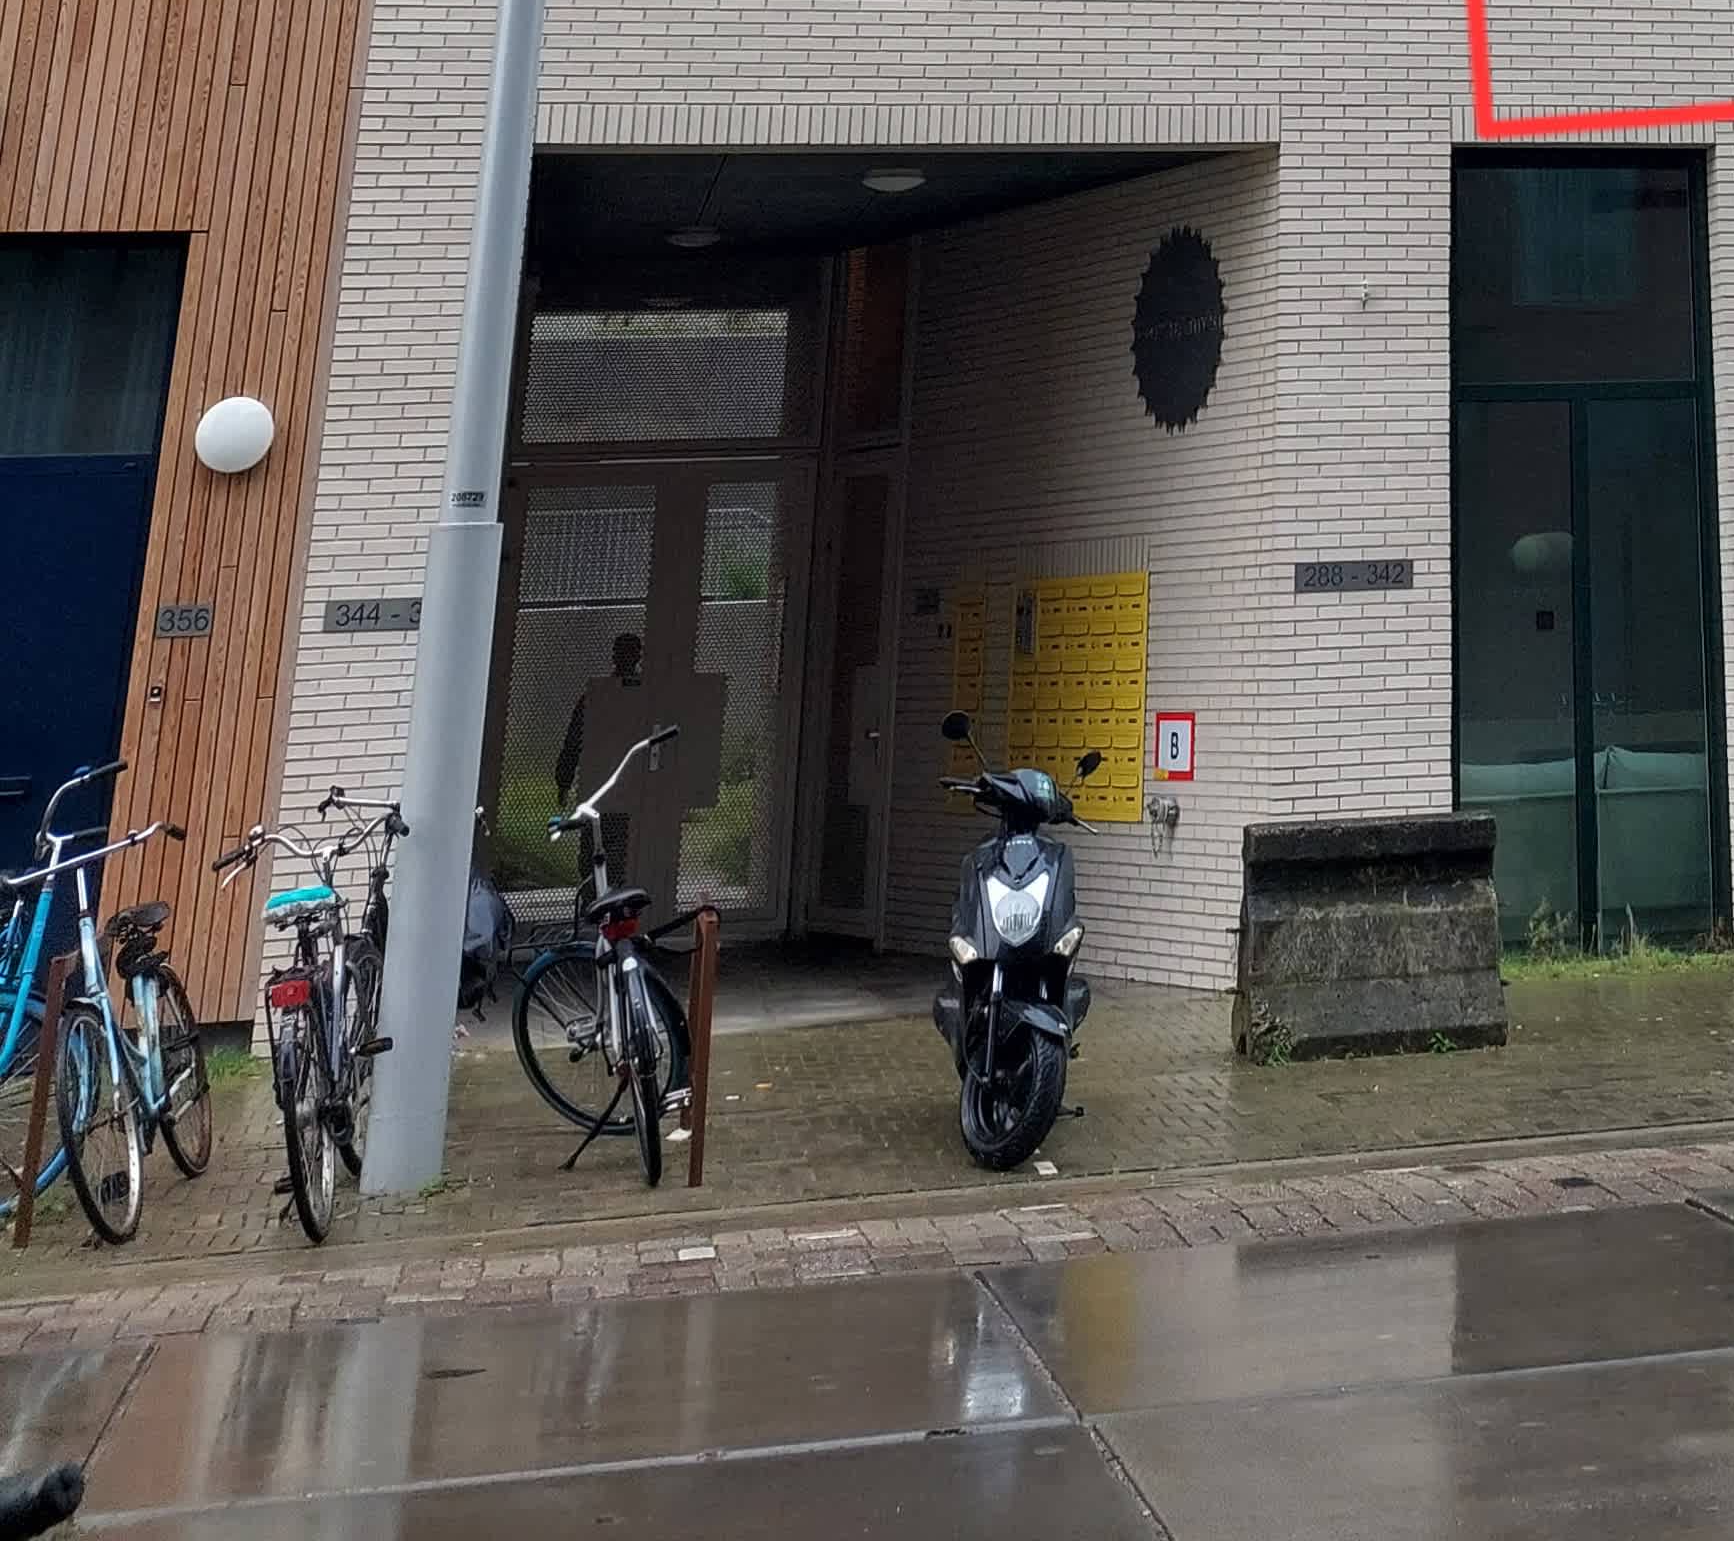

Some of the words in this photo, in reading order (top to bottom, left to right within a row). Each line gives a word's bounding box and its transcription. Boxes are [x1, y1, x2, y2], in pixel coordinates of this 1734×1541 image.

[1303, 565, 1343, 587] 288
[1367, 563, 1405, 585] 342
[160, 608, 209, 632] 356
[335, 603, 380, 626] 344
[409, 600, 422, 623] 3
